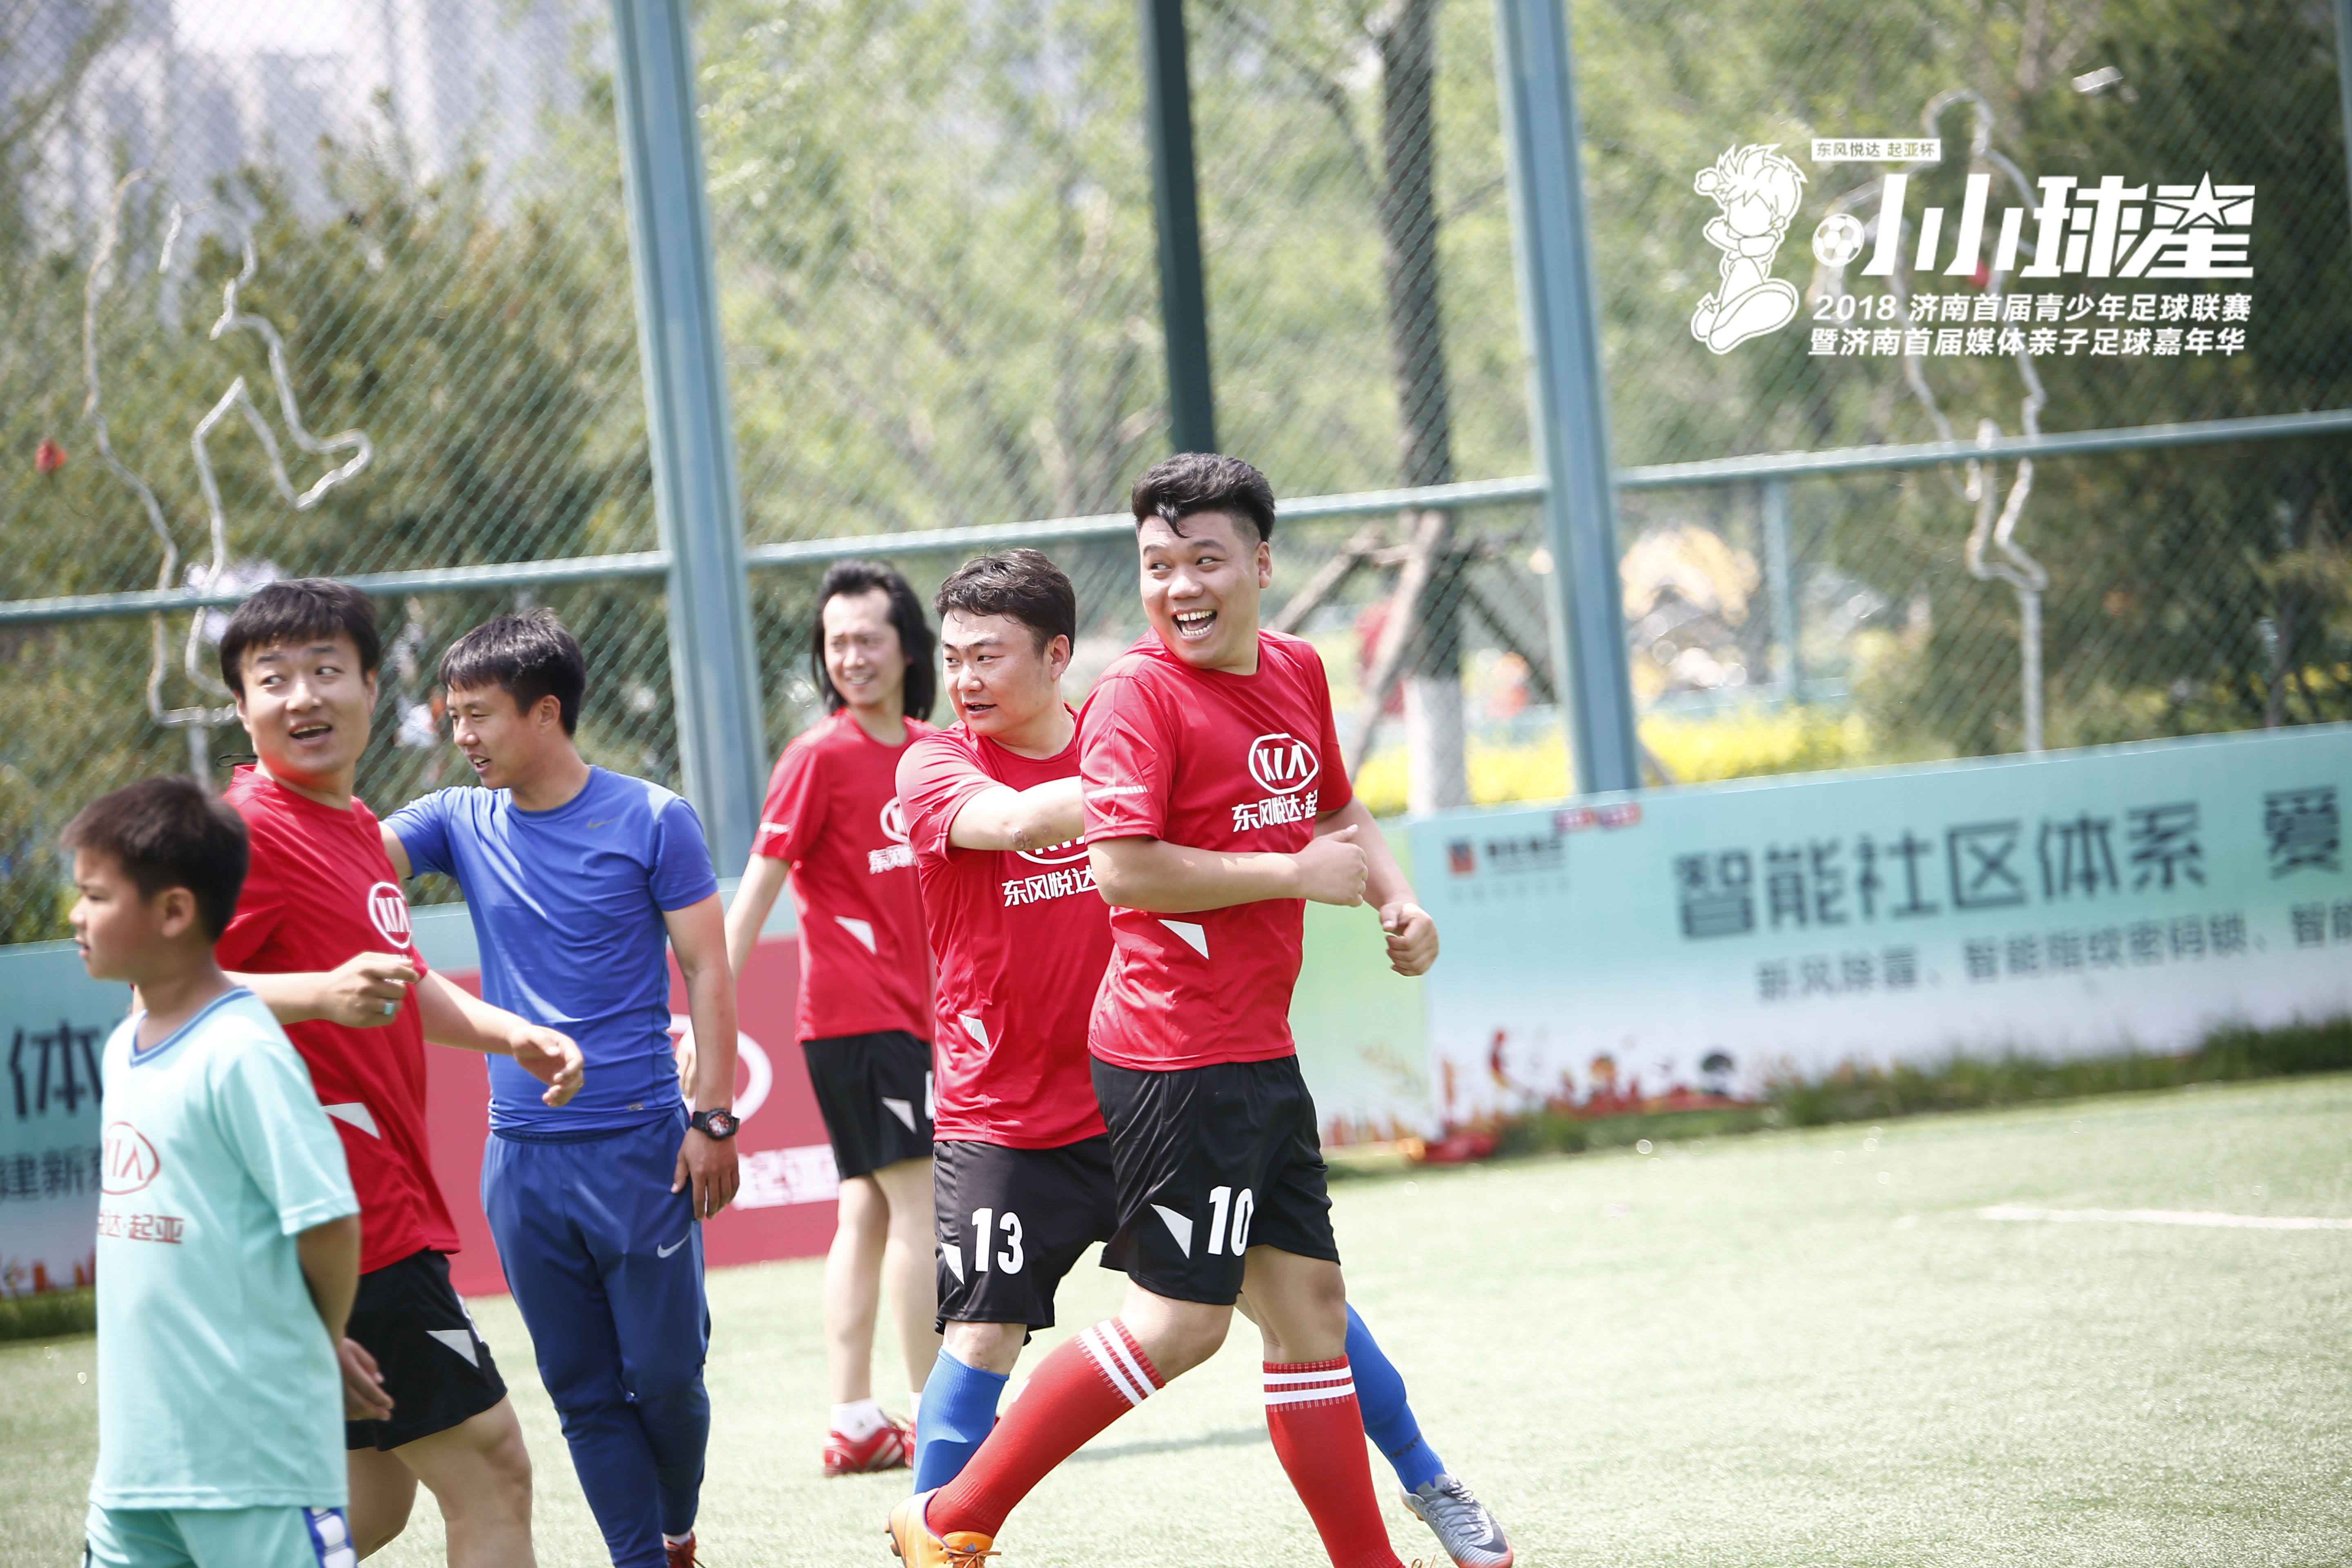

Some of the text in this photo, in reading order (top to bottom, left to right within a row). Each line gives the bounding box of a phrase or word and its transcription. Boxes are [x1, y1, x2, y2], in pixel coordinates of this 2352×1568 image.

[1002, 864, 1099, 907] 东风悦达
[1674, 784, 2343, 939] 智能社区体系 爱
[0, 1147, 101, 1203] 建新
[971, 1207, 1024, 1274] 13
[1207, 1186, 1254, 1256] 10
